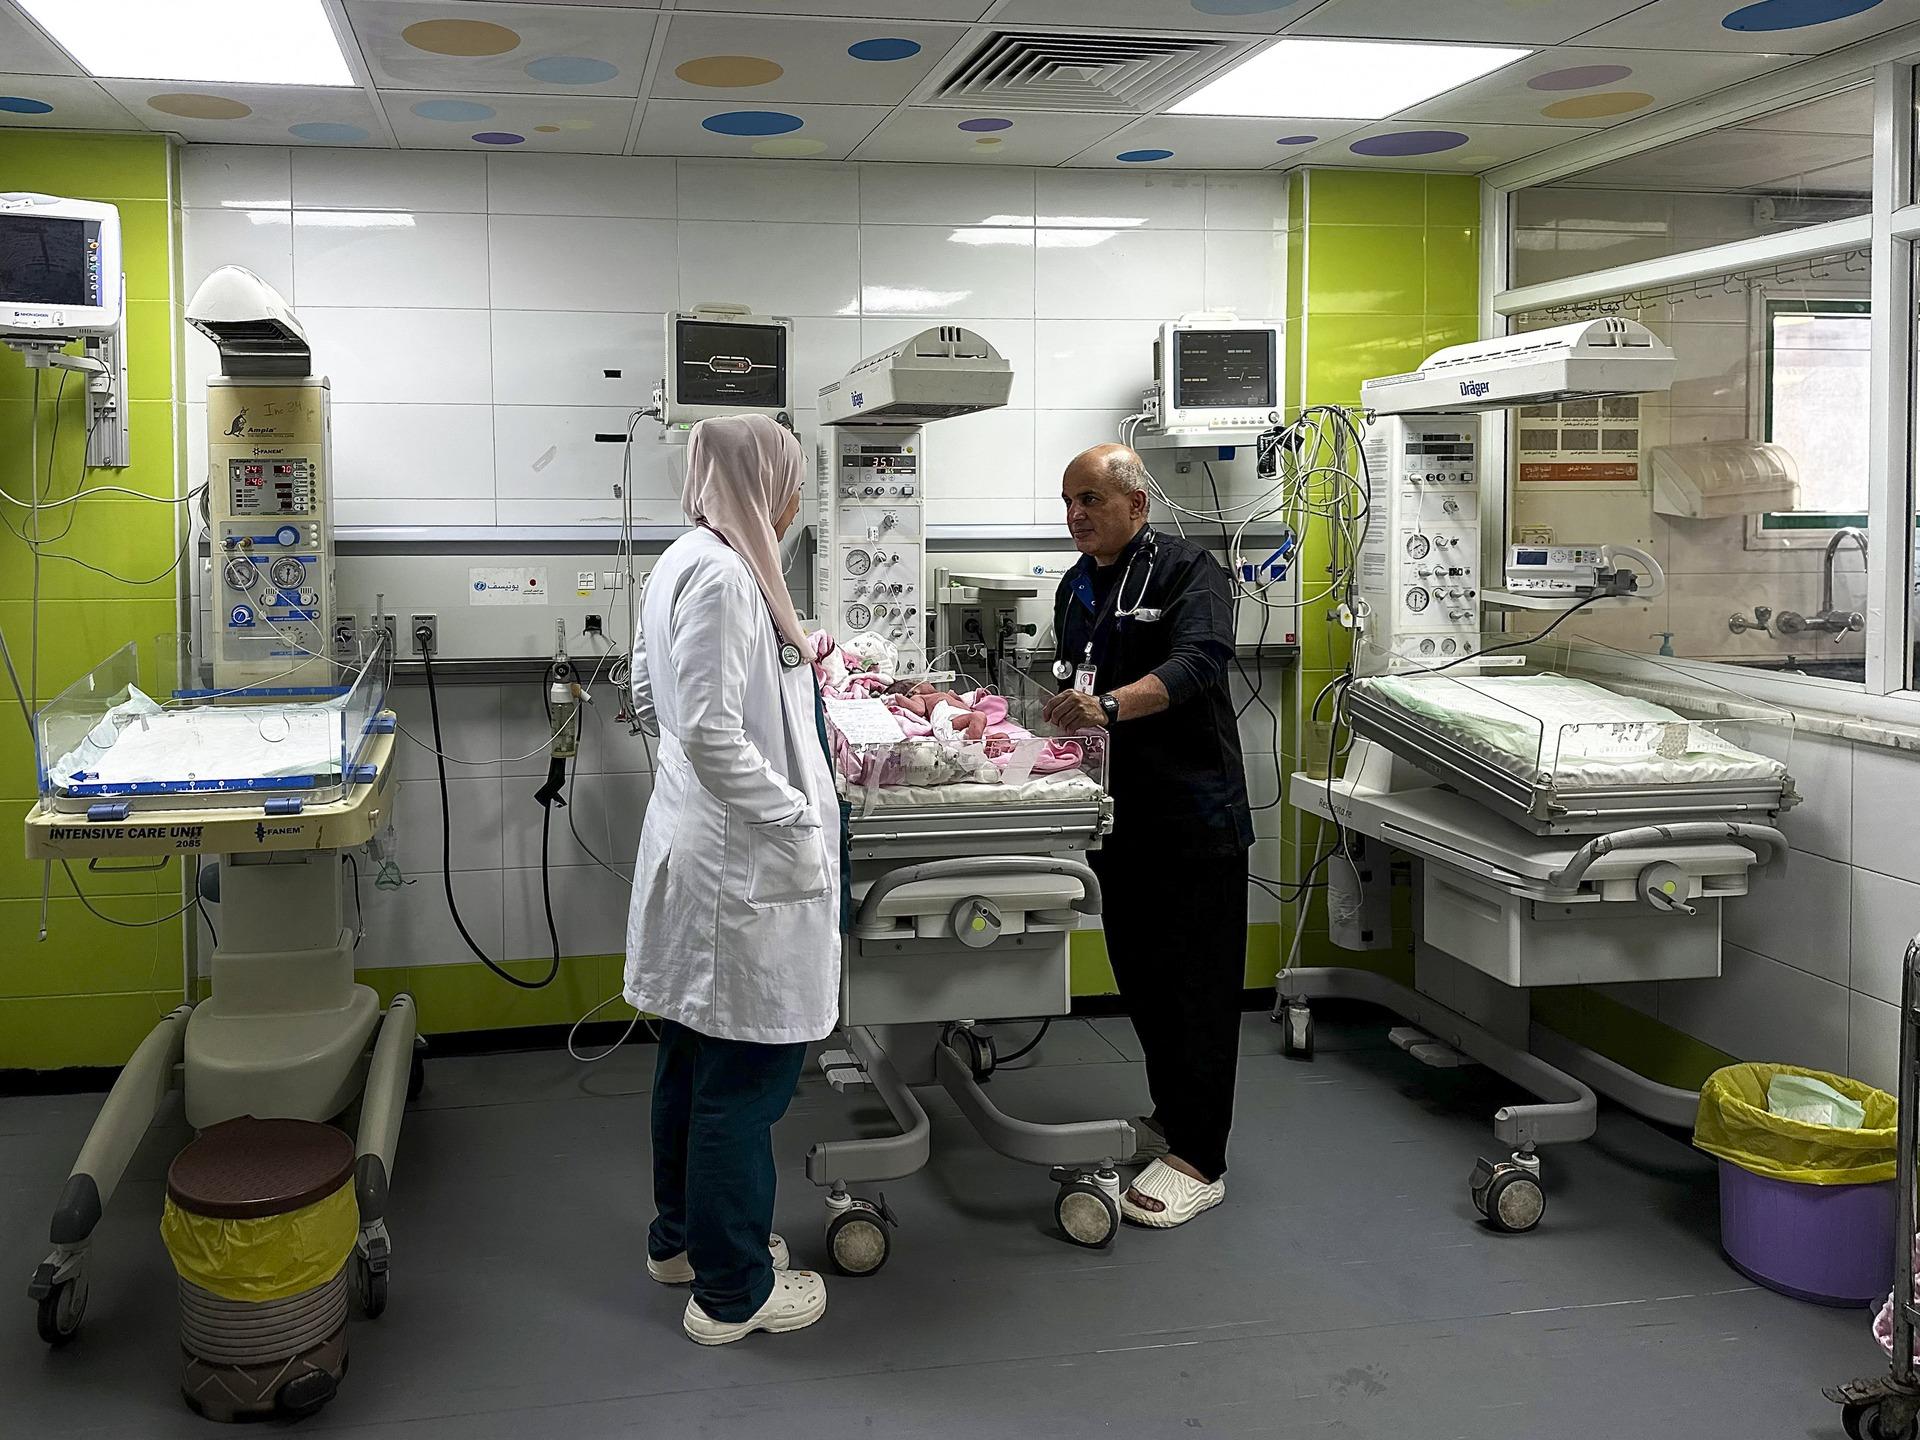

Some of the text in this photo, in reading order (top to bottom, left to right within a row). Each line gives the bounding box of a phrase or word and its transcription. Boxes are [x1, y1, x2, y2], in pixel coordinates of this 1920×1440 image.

[1459, 380, 1489, 397] Dräger
[487, 581, 519, 591] يونيسف
[49, 826, 204, 839] INTENSIVE CARE UNIT
[267, 827, 301, 836] FANEM
[176, 840, 201, 848] 2085
